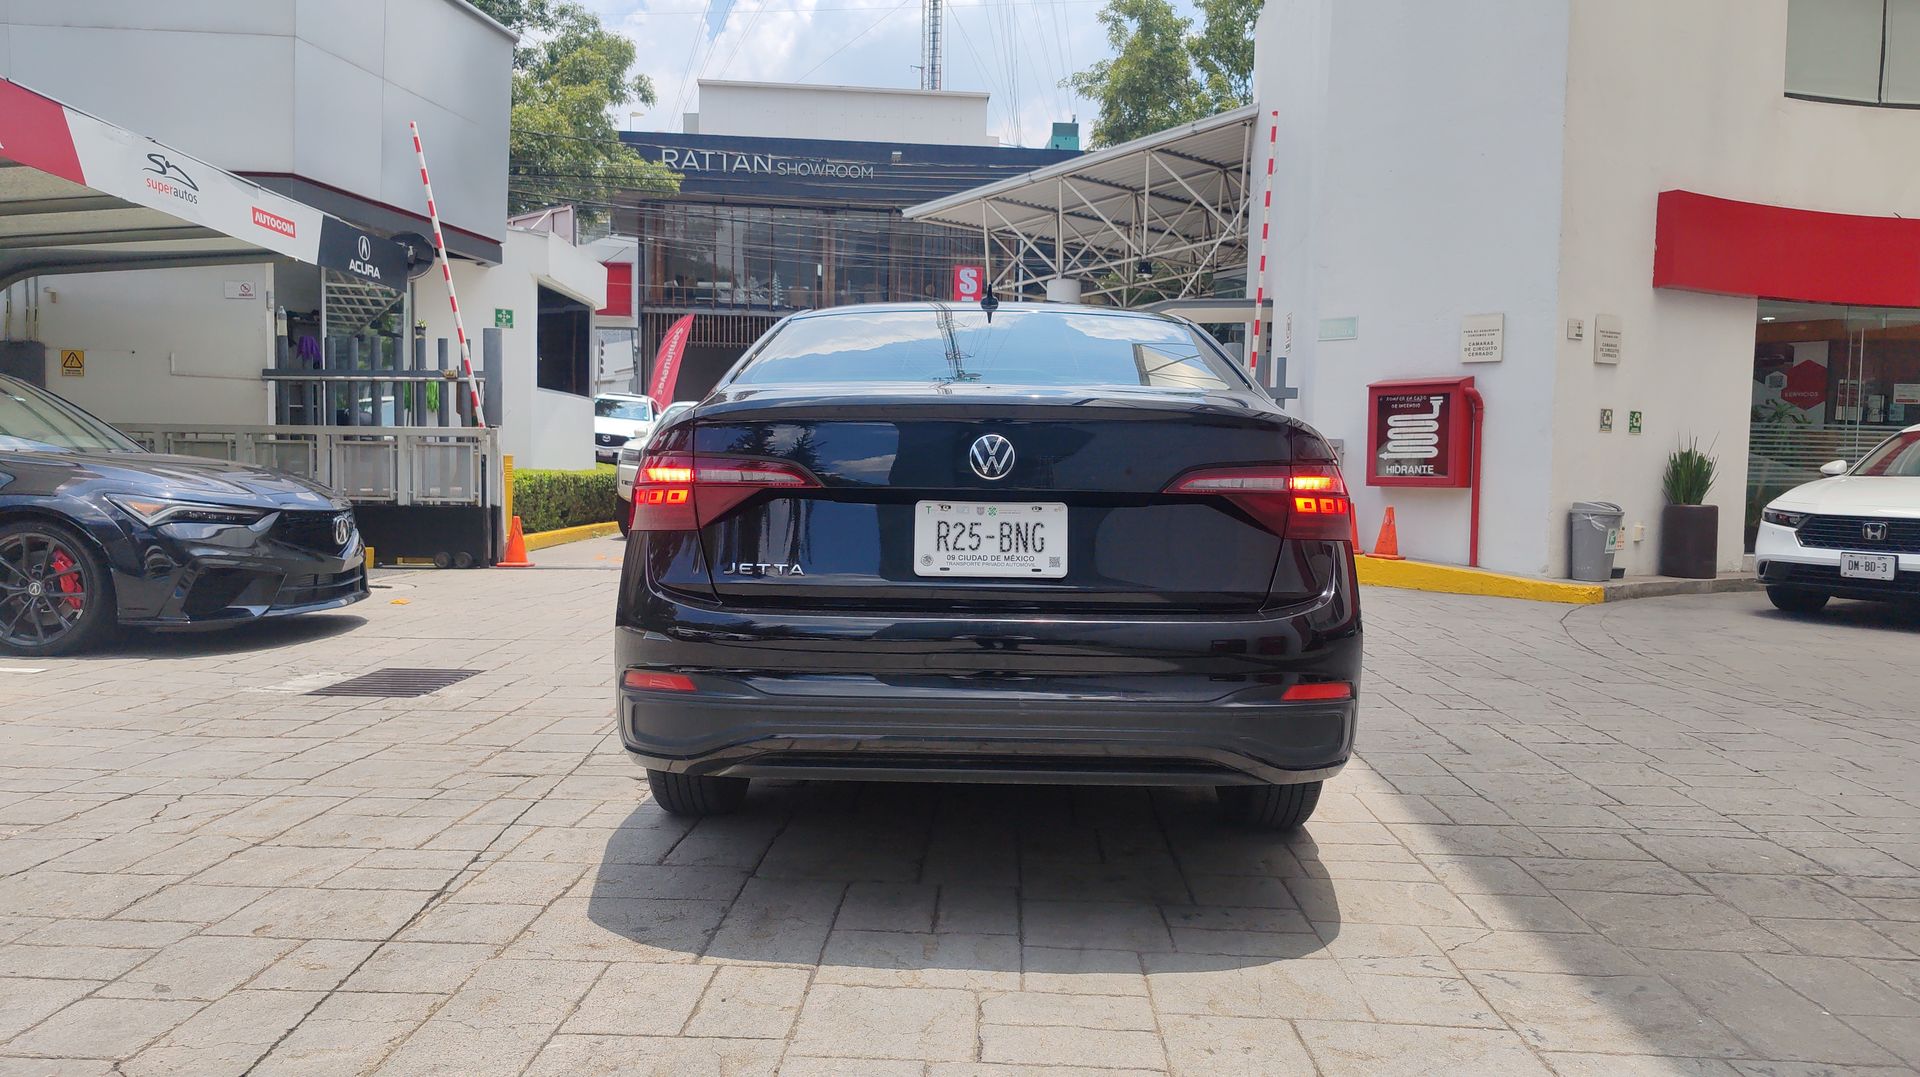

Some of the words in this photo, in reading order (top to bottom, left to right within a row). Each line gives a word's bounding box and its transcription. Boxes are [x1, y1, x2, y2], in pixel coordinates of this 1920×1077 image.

[661, 149, 772, 174] RATTAN
[777, 162, 874, 179] SHOWROOM
[146, 177, 198, 205] superautos
[254, 211, 294, 236] AUTOCOM
[349, 258, 381, 279] ACURA
[1385, 464, 1435, 475] HIDRANTE
[936, 520, 1045, 553] R25-BNG
[990, 554, 1001, 562] DE
[1003, 554, 1035, 562] MÉXICO
[1847, 560, 1888, 572] DM-BD-3
[723, 562, 805, 576] JETTA
